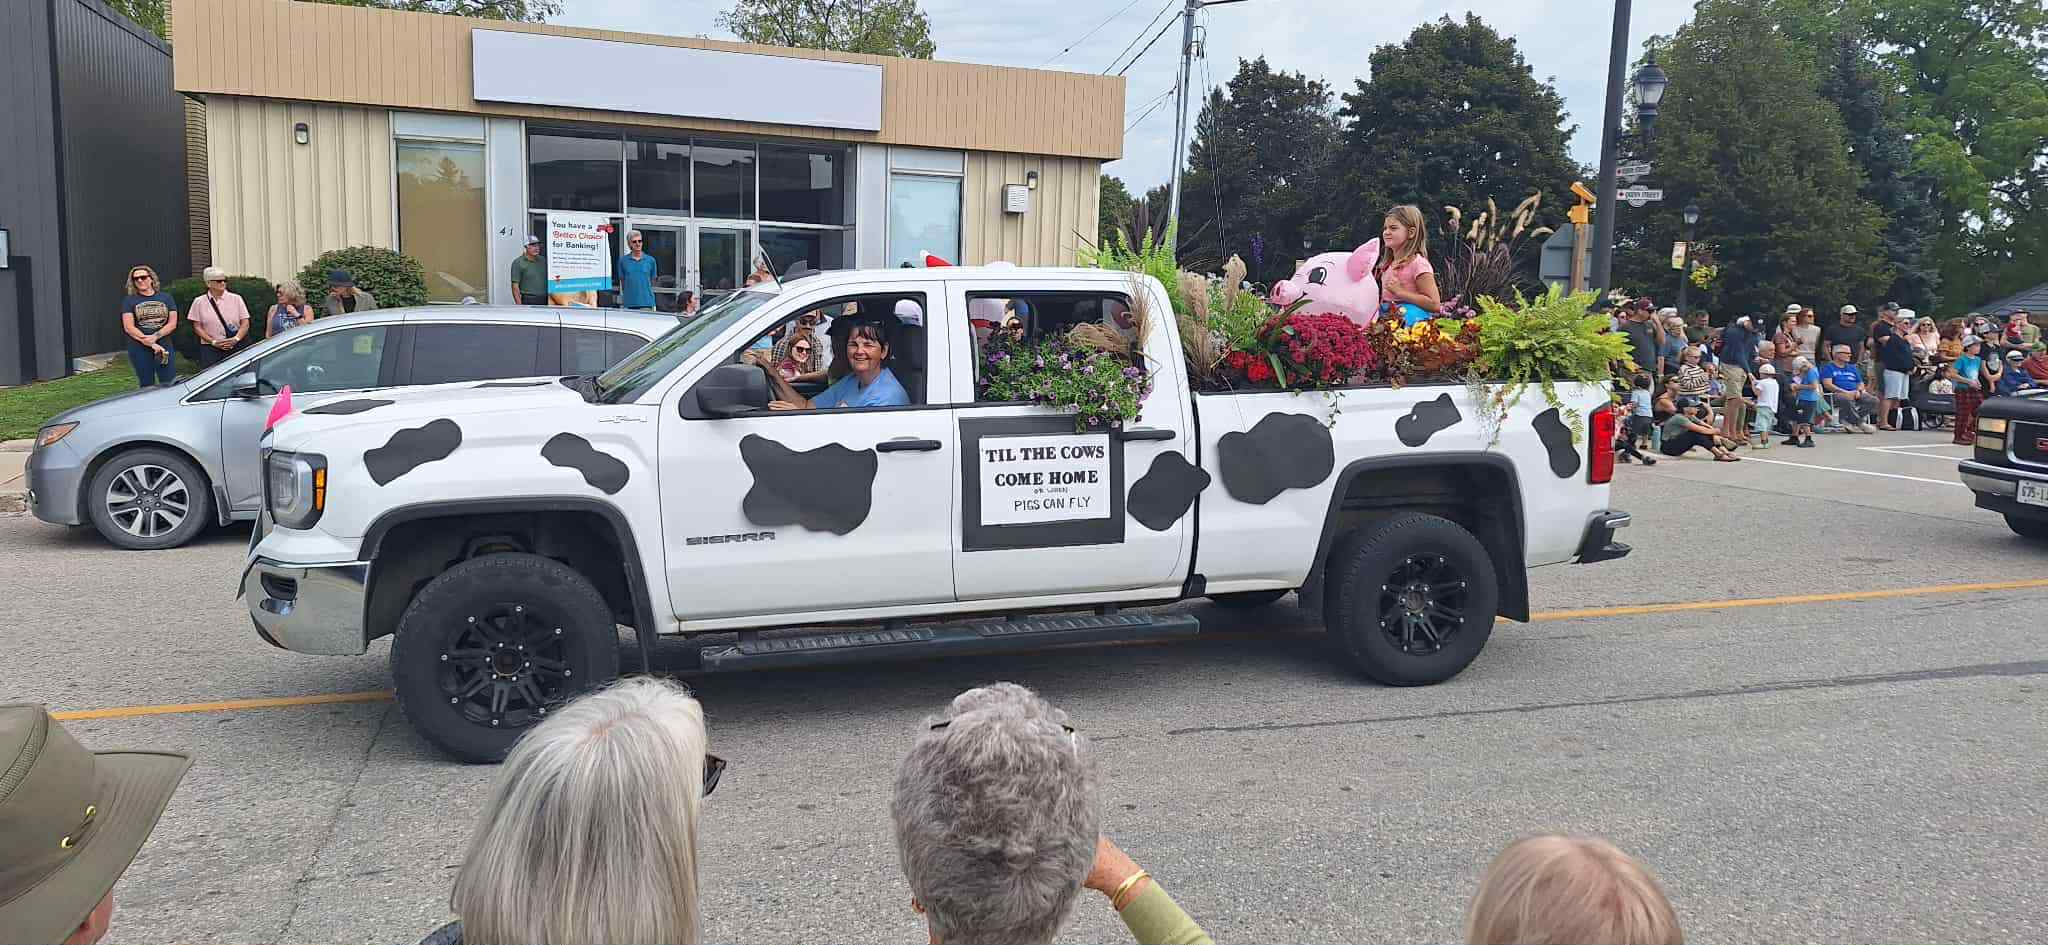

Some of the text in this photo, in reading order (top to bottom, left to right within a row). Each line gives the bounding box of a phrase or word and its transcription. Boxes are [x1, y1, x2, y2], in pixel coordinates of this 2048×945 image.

[552, 221, 567, 229] You
[568, 220, 587, 230] have
[565, 241, 600, 251] Banking!
[1020, 447, 1057, 461] THE
[1060, 445, 1105, 460] COWS
[995, 470, 1099, 487] COME HOME
[1014, 496, 1091, 512] PIGS CAN FLY
[686, 532, 775, 545] SIERRA
